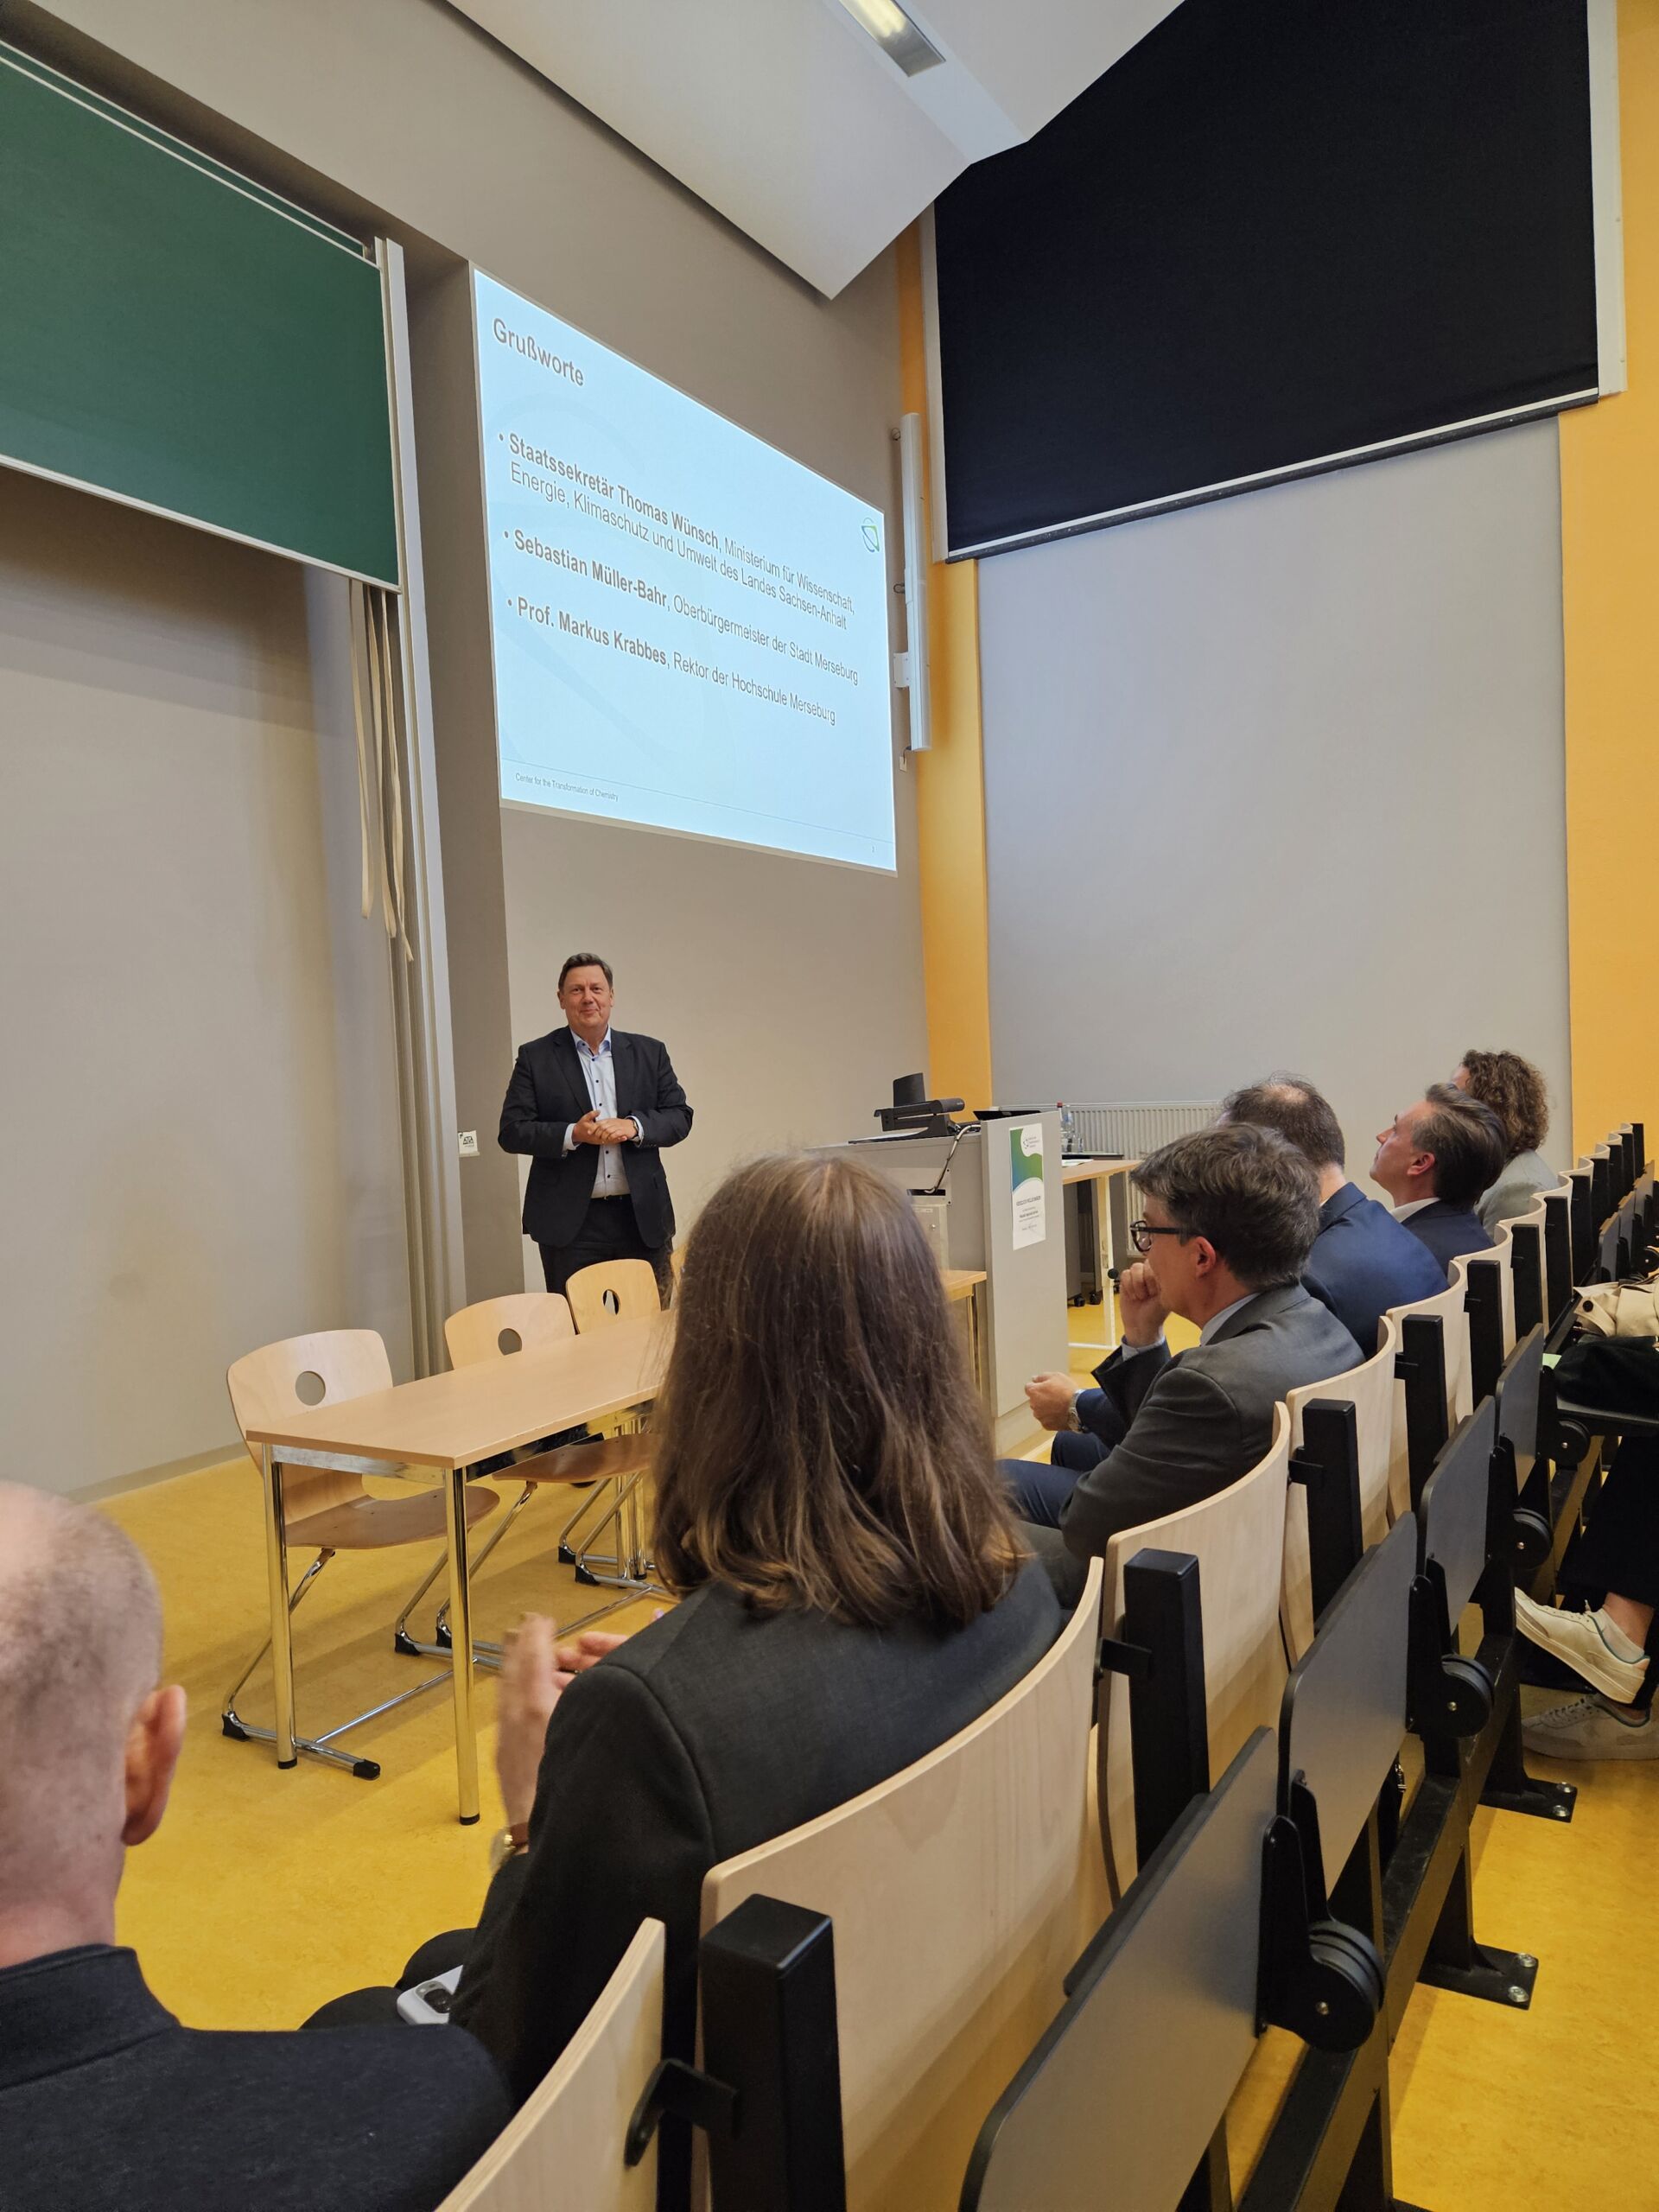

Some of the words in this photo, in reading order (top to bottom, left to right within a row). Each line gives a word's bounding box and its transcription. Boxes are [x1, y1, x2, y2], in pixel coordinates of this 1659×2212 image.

[493, 318, 584, 386] Grußworte
[510, 433, 614, 499] Staatssekretär
[618, 485, 668, 525] Thomas
[671, 511, 721, 553] Wünsch,
[725, 537, 780, 578] Ministerium
[782, 565, 795, 584] für
[797, 572, 855, 615] Wissenschaft,
[511, 461, 570, 509] Energie,
[574, 490, 650, 542] Klimaschutz
[652, 531, 673, 552] und
[677, 538, 717, 573] Umwelt
[721, 561, 739, 581] des
[741, 568, 776, 598] Landes
[779, 586, 847, 630] Sachsen-Anhalt
[514, 529, 588, 575] Sebastian
[592, 560, 671, 612] Müller-Bahr,
[674, 594, 769, 646] Oberbürgermeister
[772, 636, 787, 654] der
[790, 642, 813, 664] Stadt
[815, 652, 858, 686] Merseburg
[518, 596, 554, 626] Prof.
[559, 611, 609, 645] Markus
[613, 630, 671, 669] Krabbes,
[674, 652, 709, 679] Rektor
[712, 667, 729, 685] der
[732, 672, 787, 706] Hochschule
[790, 693, 836, 726] Merseburg
[515, 772, 533, 783] Center
[553, 780, 588, 795] Transformation
